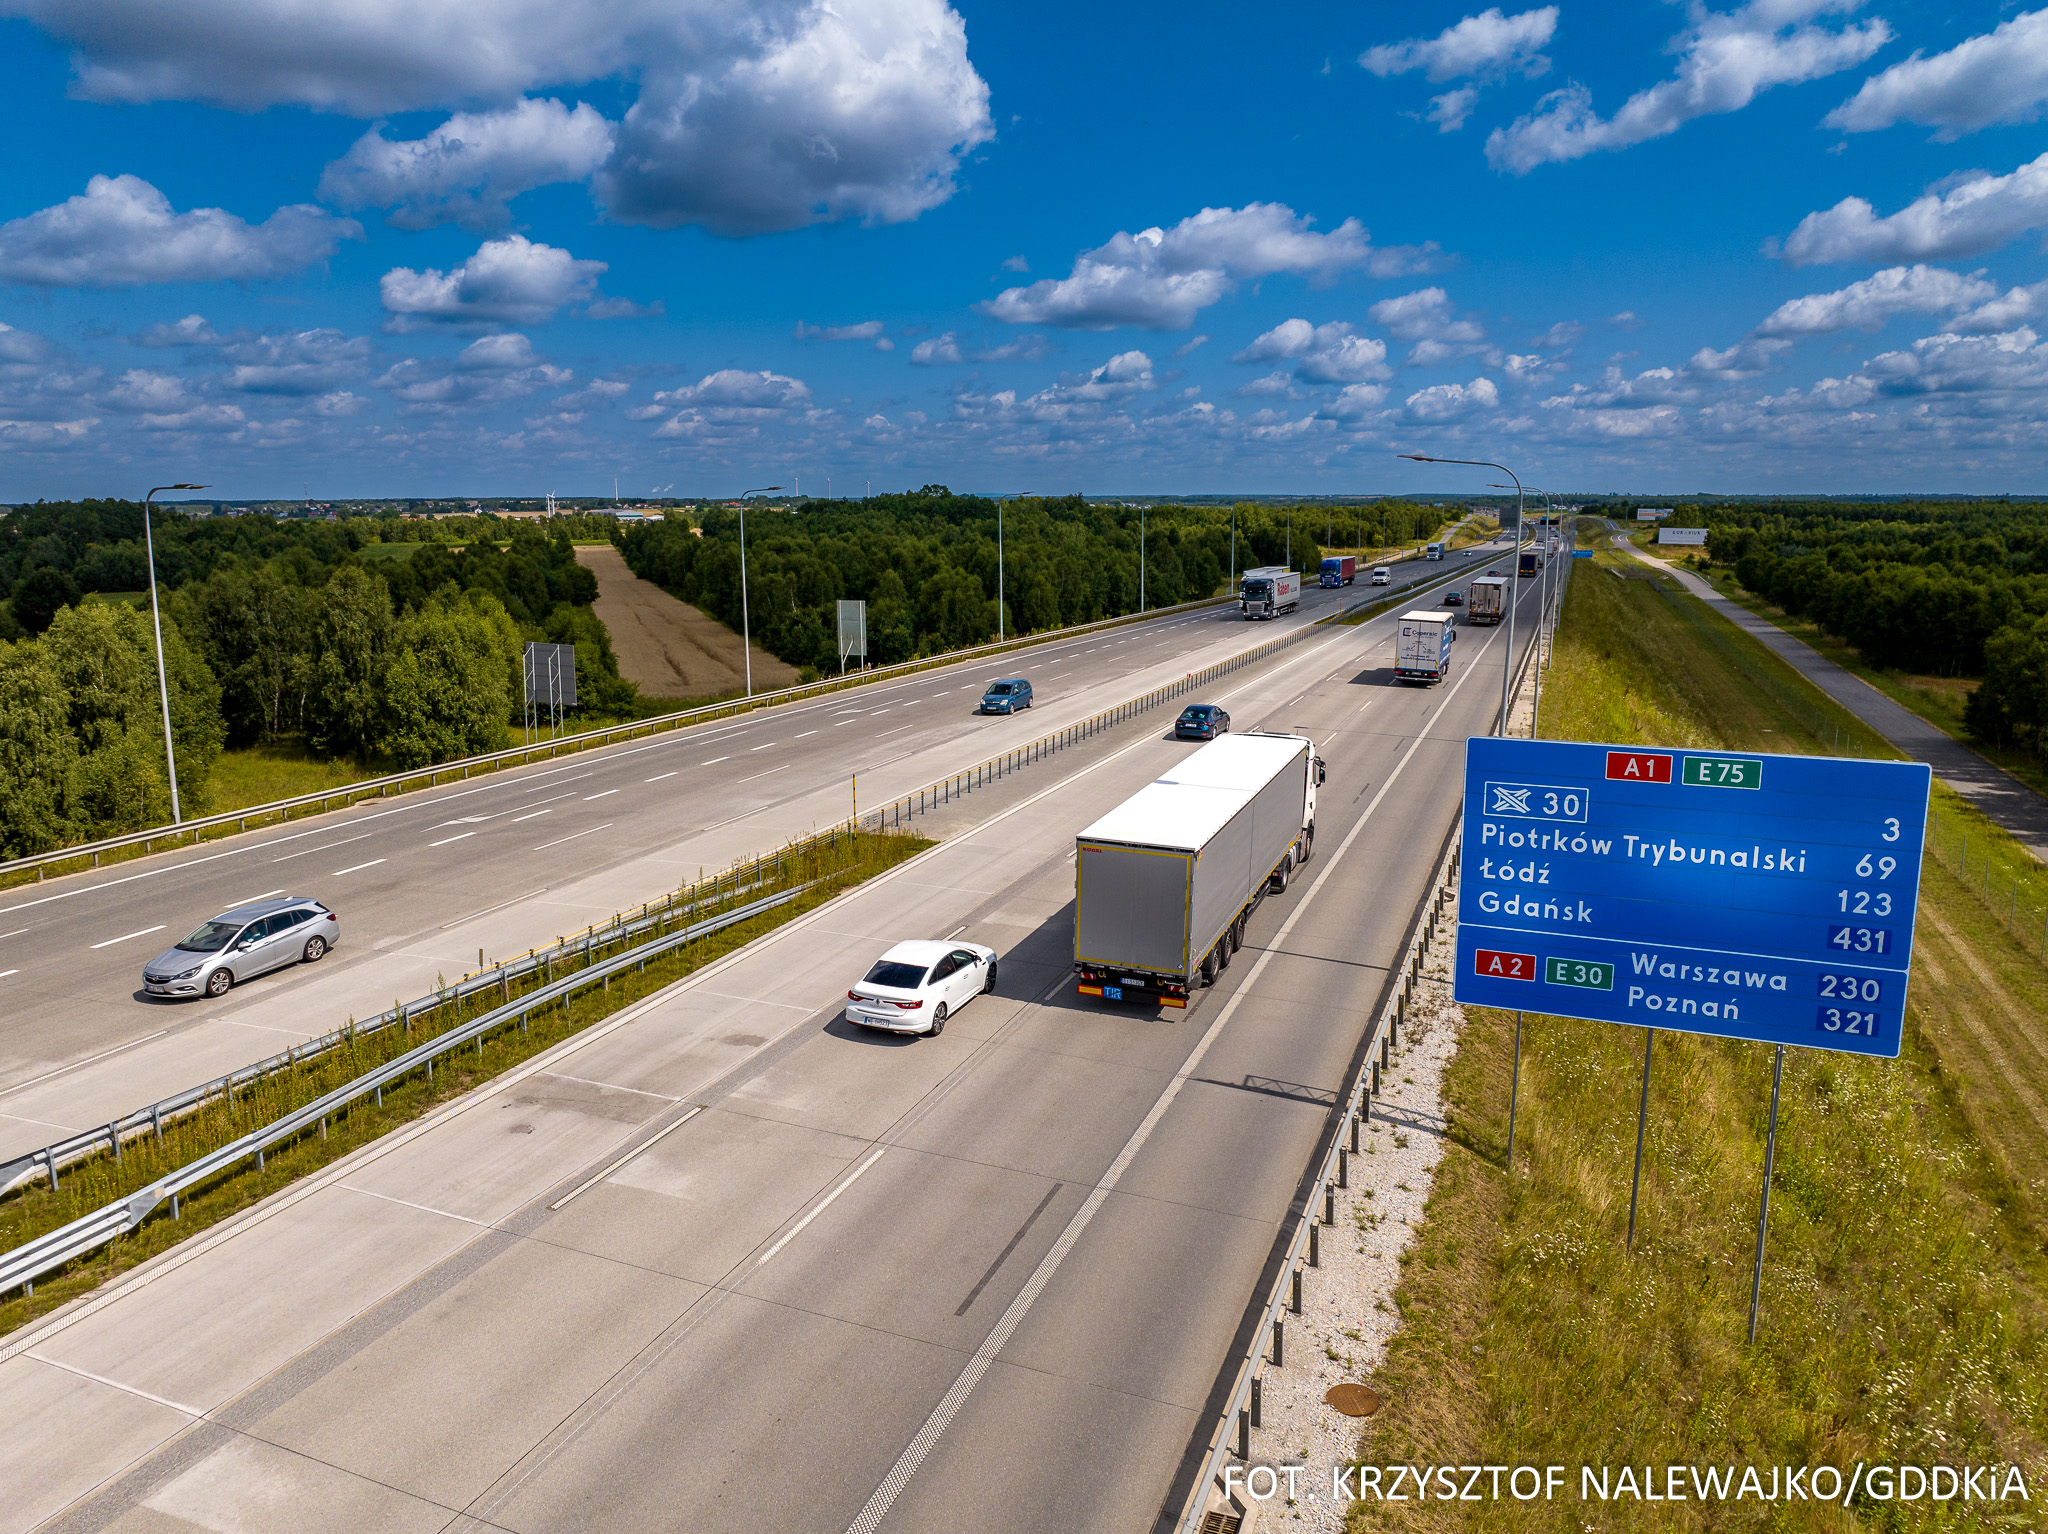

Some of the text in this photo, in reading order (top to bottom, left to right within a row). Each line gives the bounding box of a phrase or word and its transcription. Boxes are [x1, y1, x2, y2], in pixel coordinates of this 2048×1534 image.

[1624, 758, 1744, 783] A1 E75
[1542, 792, 1900, 842] 30 3
[1481, 823, 1897, 880] Piotrków Trybunalski 69
[1479, 857, 1892, 917] Łódź 123
[1478, 891, 1885, 953] Gdańsk 431
[1105, 988, 1121, 999] TIR
[1488, 955, 1602, 984] A2 E30
[1631, 952, 1880, 1002] Warszawa 230
[1628, 986, 1874, 1035] Poznań 321
